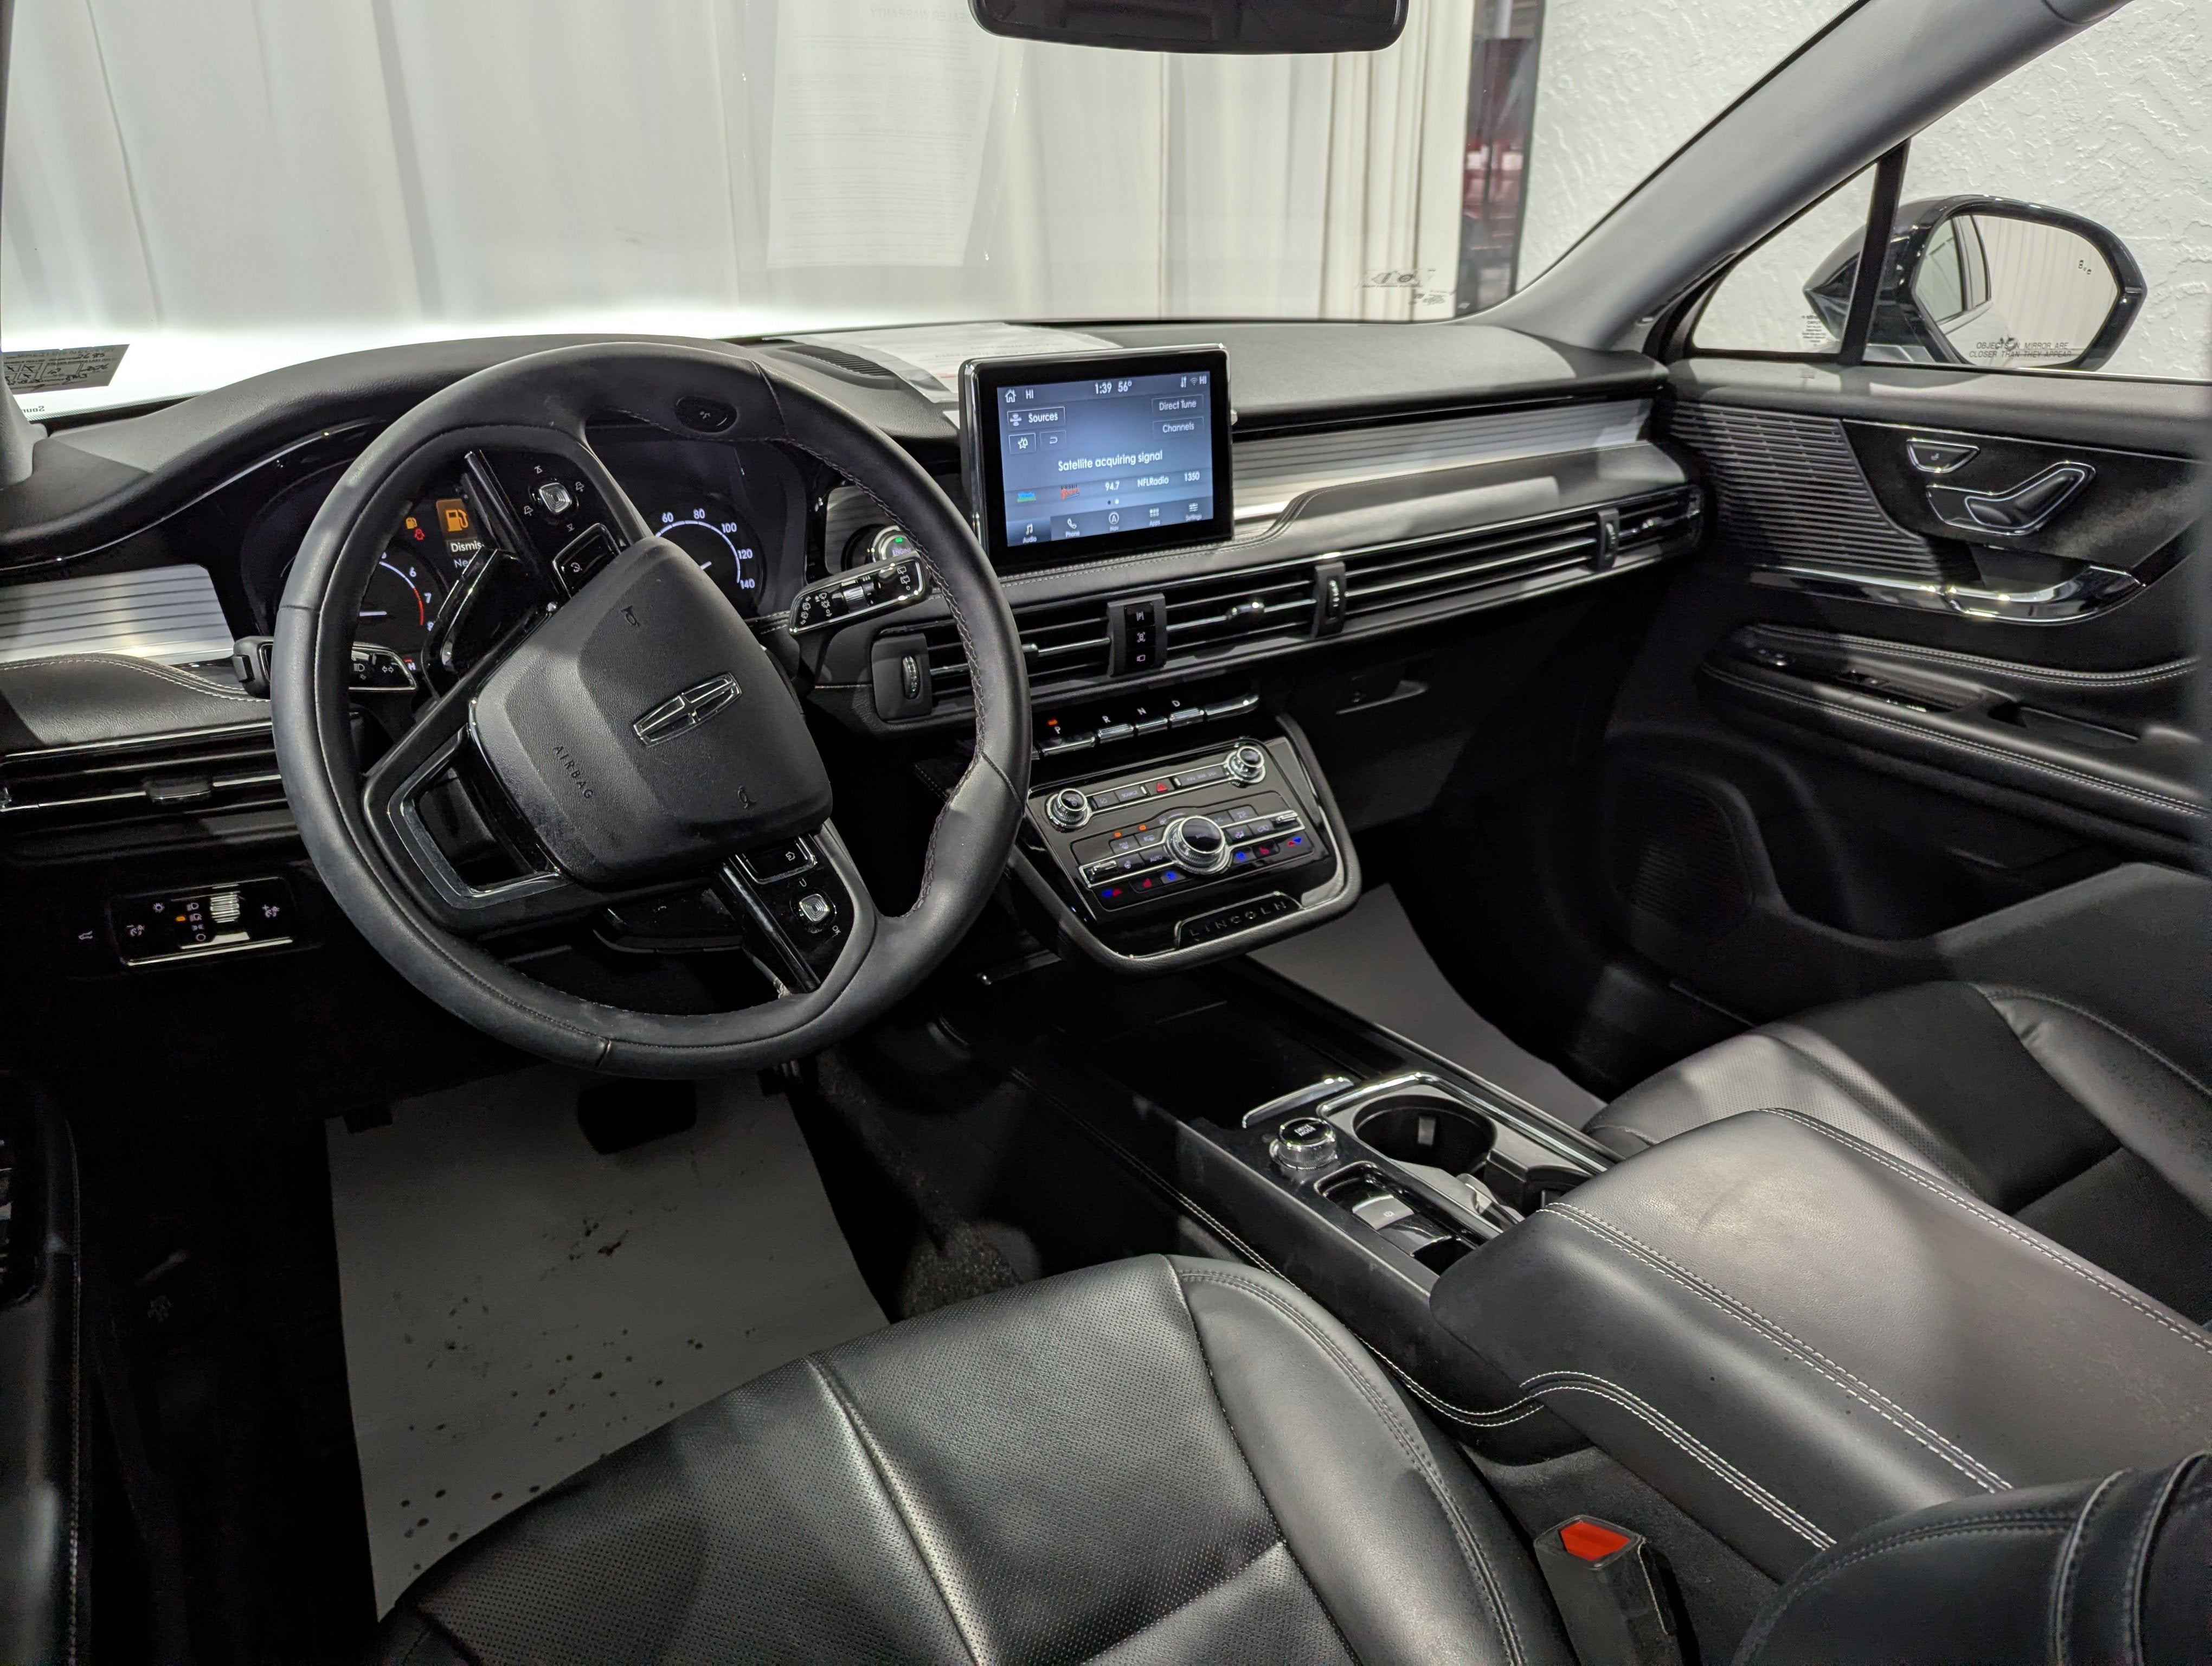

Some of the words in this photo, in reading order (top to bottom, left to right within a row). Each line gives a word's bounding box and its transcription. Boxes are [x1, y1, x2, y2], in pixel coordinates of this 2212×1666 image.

[1976, 342, 2009, 350] OBJECTS
[1199, 375, 1207, 385] HI
[1025, 388, 1034, 400] HI
[1095, 381, 1113, 395] 1:39
[1159, 400, 1180, 411] Direct
[1180, 399, 1197, 409] Tune
[1028, 412, 1059, 424] Sources
[1162, 421, 1195, 433] Channels
[1058, 458, 1093, 472] Satellite
[1095, 453, 1136, 468] acquiring
[1138, 448, 1163, 464] signal
[1105, 480, 1120, 491] 94.7
[1184, 470, 1200, 482] 1350
[661, 511, 674, 524] 60
[693, 508, 705, 520] 80
[721, 522, 738, 534] 100
[1023, 536, 1037, 544] Audio
[451, 540, 484, 553] Dismis
[737, 548, 753, 560] 120
[409, 566, 417, 578] 6
[740, 578, 756, 590] 140
[424, 592, 432, 604] 7
[1053, 726, 1061, 735] P
[1102, 715, 1111, 724] R
[1136, 707, 1147, 715] N
[1171, 699, 1180, 708] D
[552, 746, 594, 799] AIRBAG
[1150, 855, 1163, 863] AUTO
[1189, 901, 1287, 937] LINCOLN
[832, 925, 841, 937] OK
